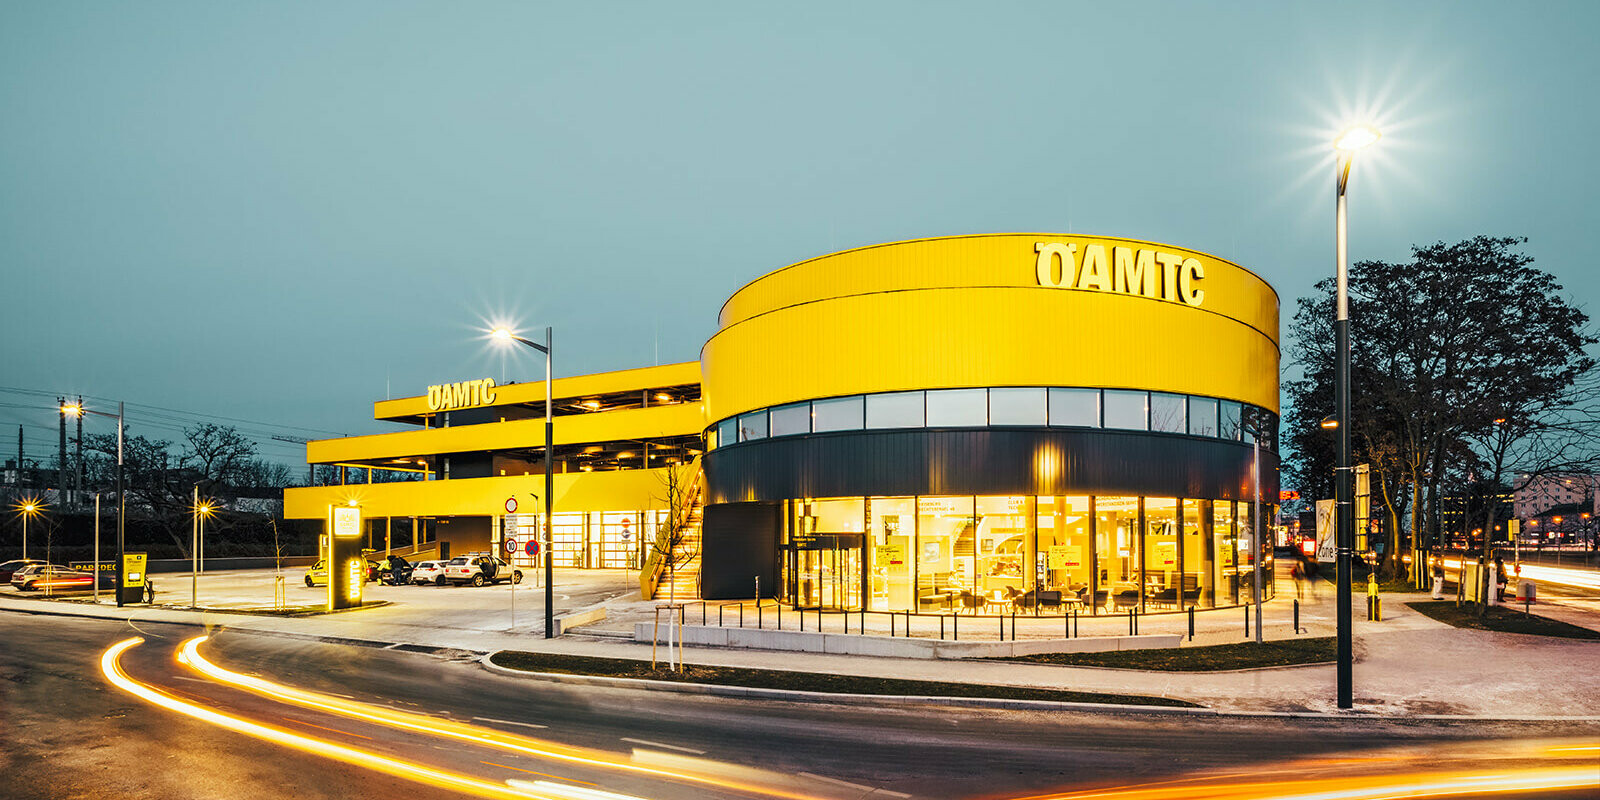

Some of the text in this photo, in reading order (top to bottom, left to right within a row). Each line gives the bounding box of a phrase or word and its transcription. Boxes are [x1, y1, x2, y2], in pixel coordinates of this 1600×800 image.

[1034, 241, 1205, 307] ÖAMTC
[427, 377, 496, 411] ÖAMTC
[508, 541, 515, 551] 10
[350, 560, 361, 599] ÖAMTC
